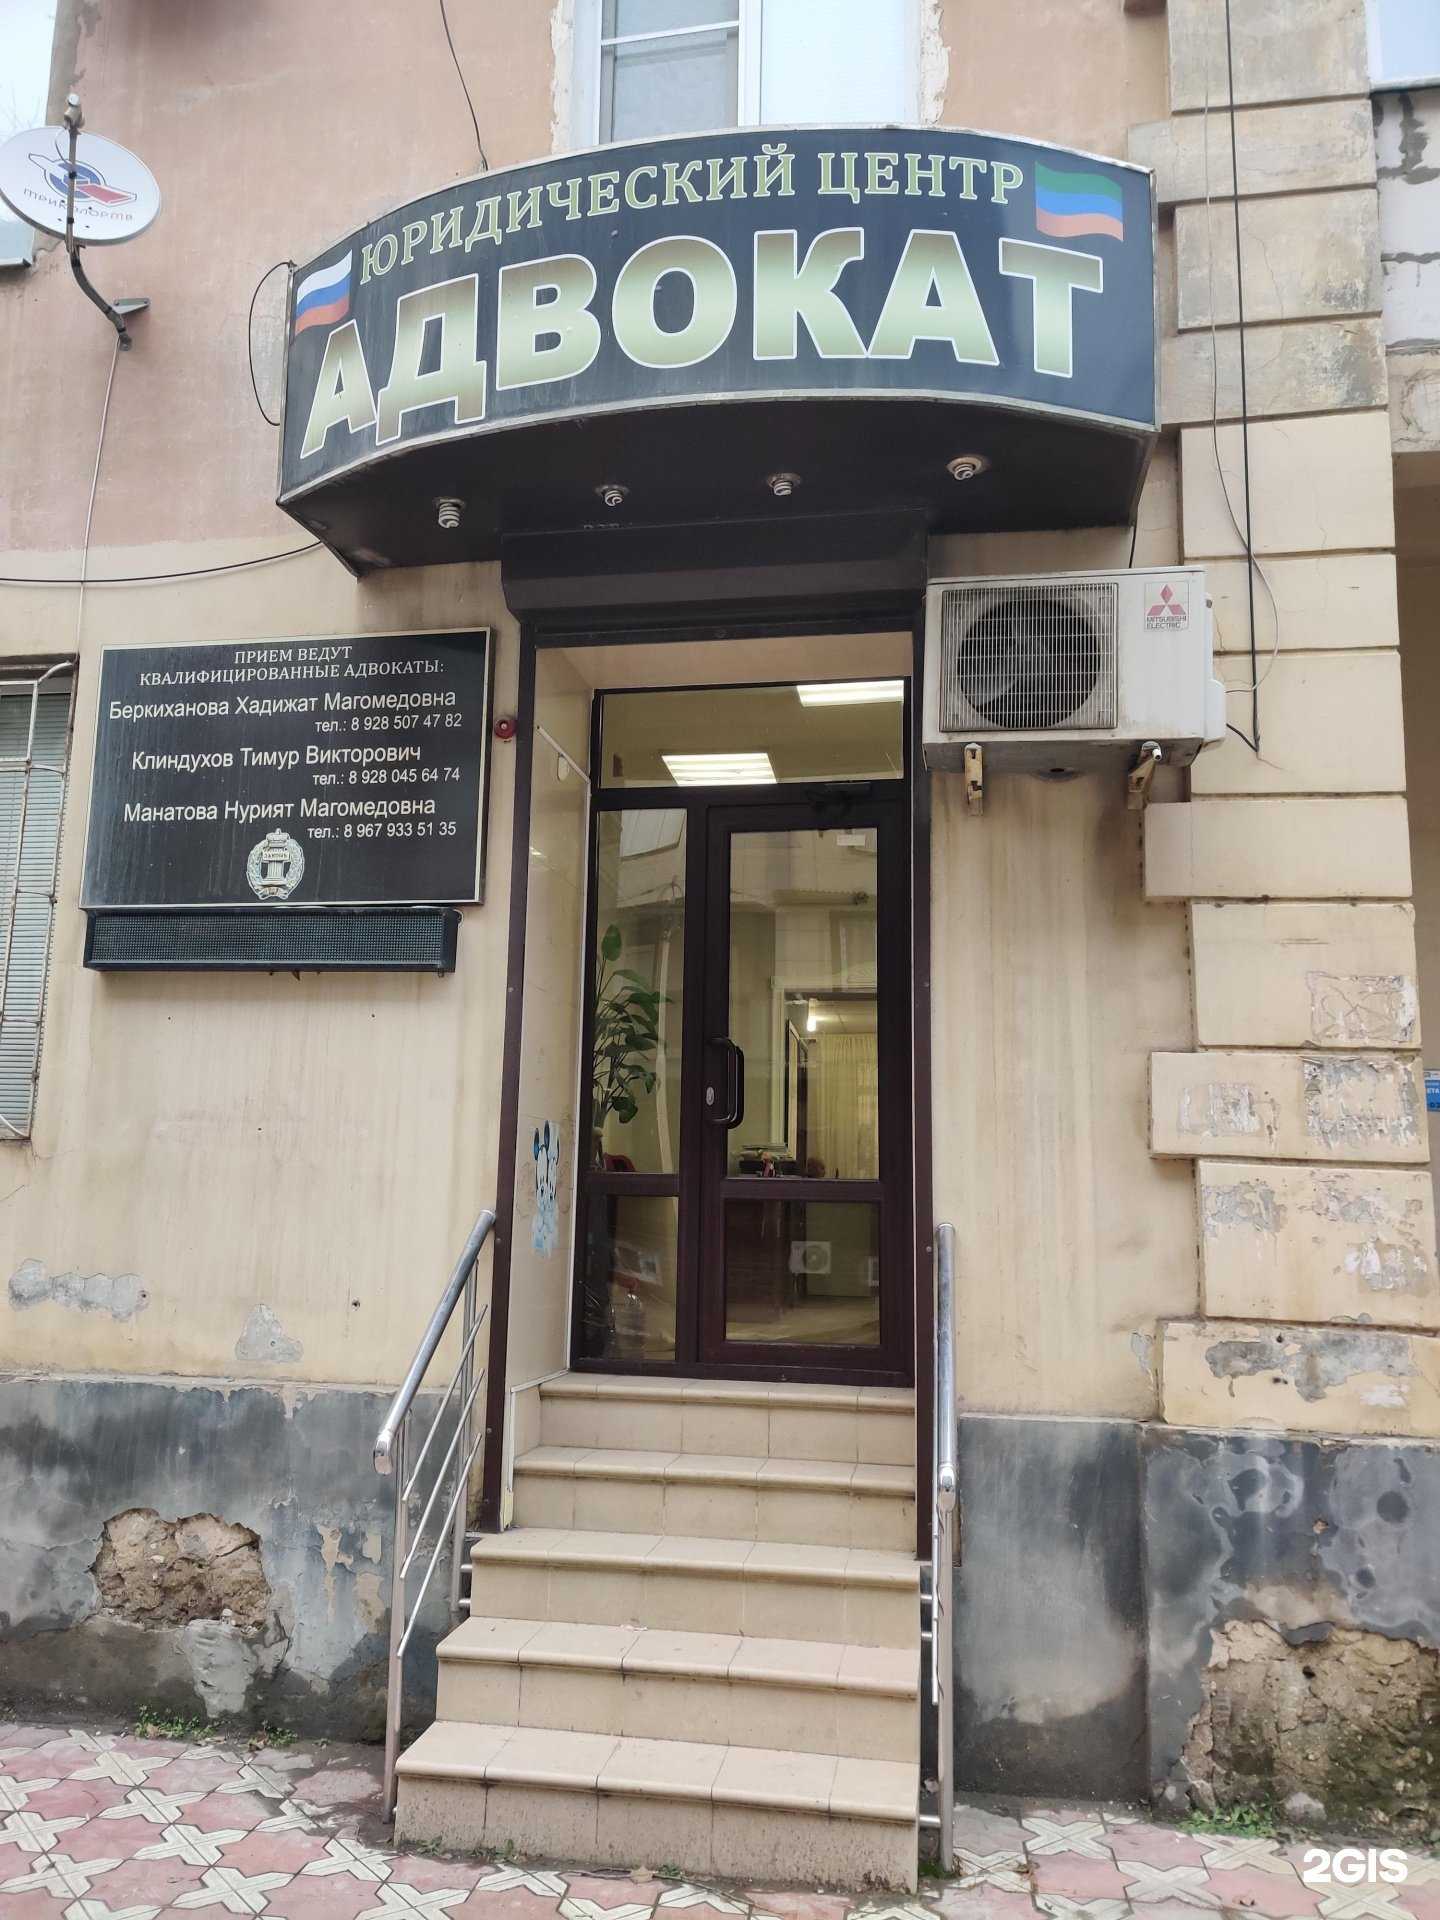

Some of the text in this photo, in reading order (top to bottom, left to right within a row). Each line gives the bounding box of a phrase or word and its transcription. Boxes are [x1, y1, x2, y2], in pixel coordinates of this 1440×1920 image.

[359, 142, 1024, 285] ЮРИДИЧЕСКИЙ ЦЕНТР
[300, 226, 1104, 460] АДВОКАТ
[234, 645, 353, 665] ПРИЕМ ВЕДУТ
[140, 659, 444, 686] КВАЛИФИЦИРОВАННЫЕ АДВОКАТЫ:
[109, 691, 456, 723] Беркиханова Хадижат Магомедовна
[315, 712, 462, 732] тел.: 8 928 507 47 82
[132, 745, 421, 773] Клиндухов Тимур Викторович
[312, 767, 460, 785] тел.: 8 928 045 64 74
[123, 798, 435, 824] Манатова Нурият Магомедовна
[307, 821, 457, 838] тел.: 8 967 933 51 35
